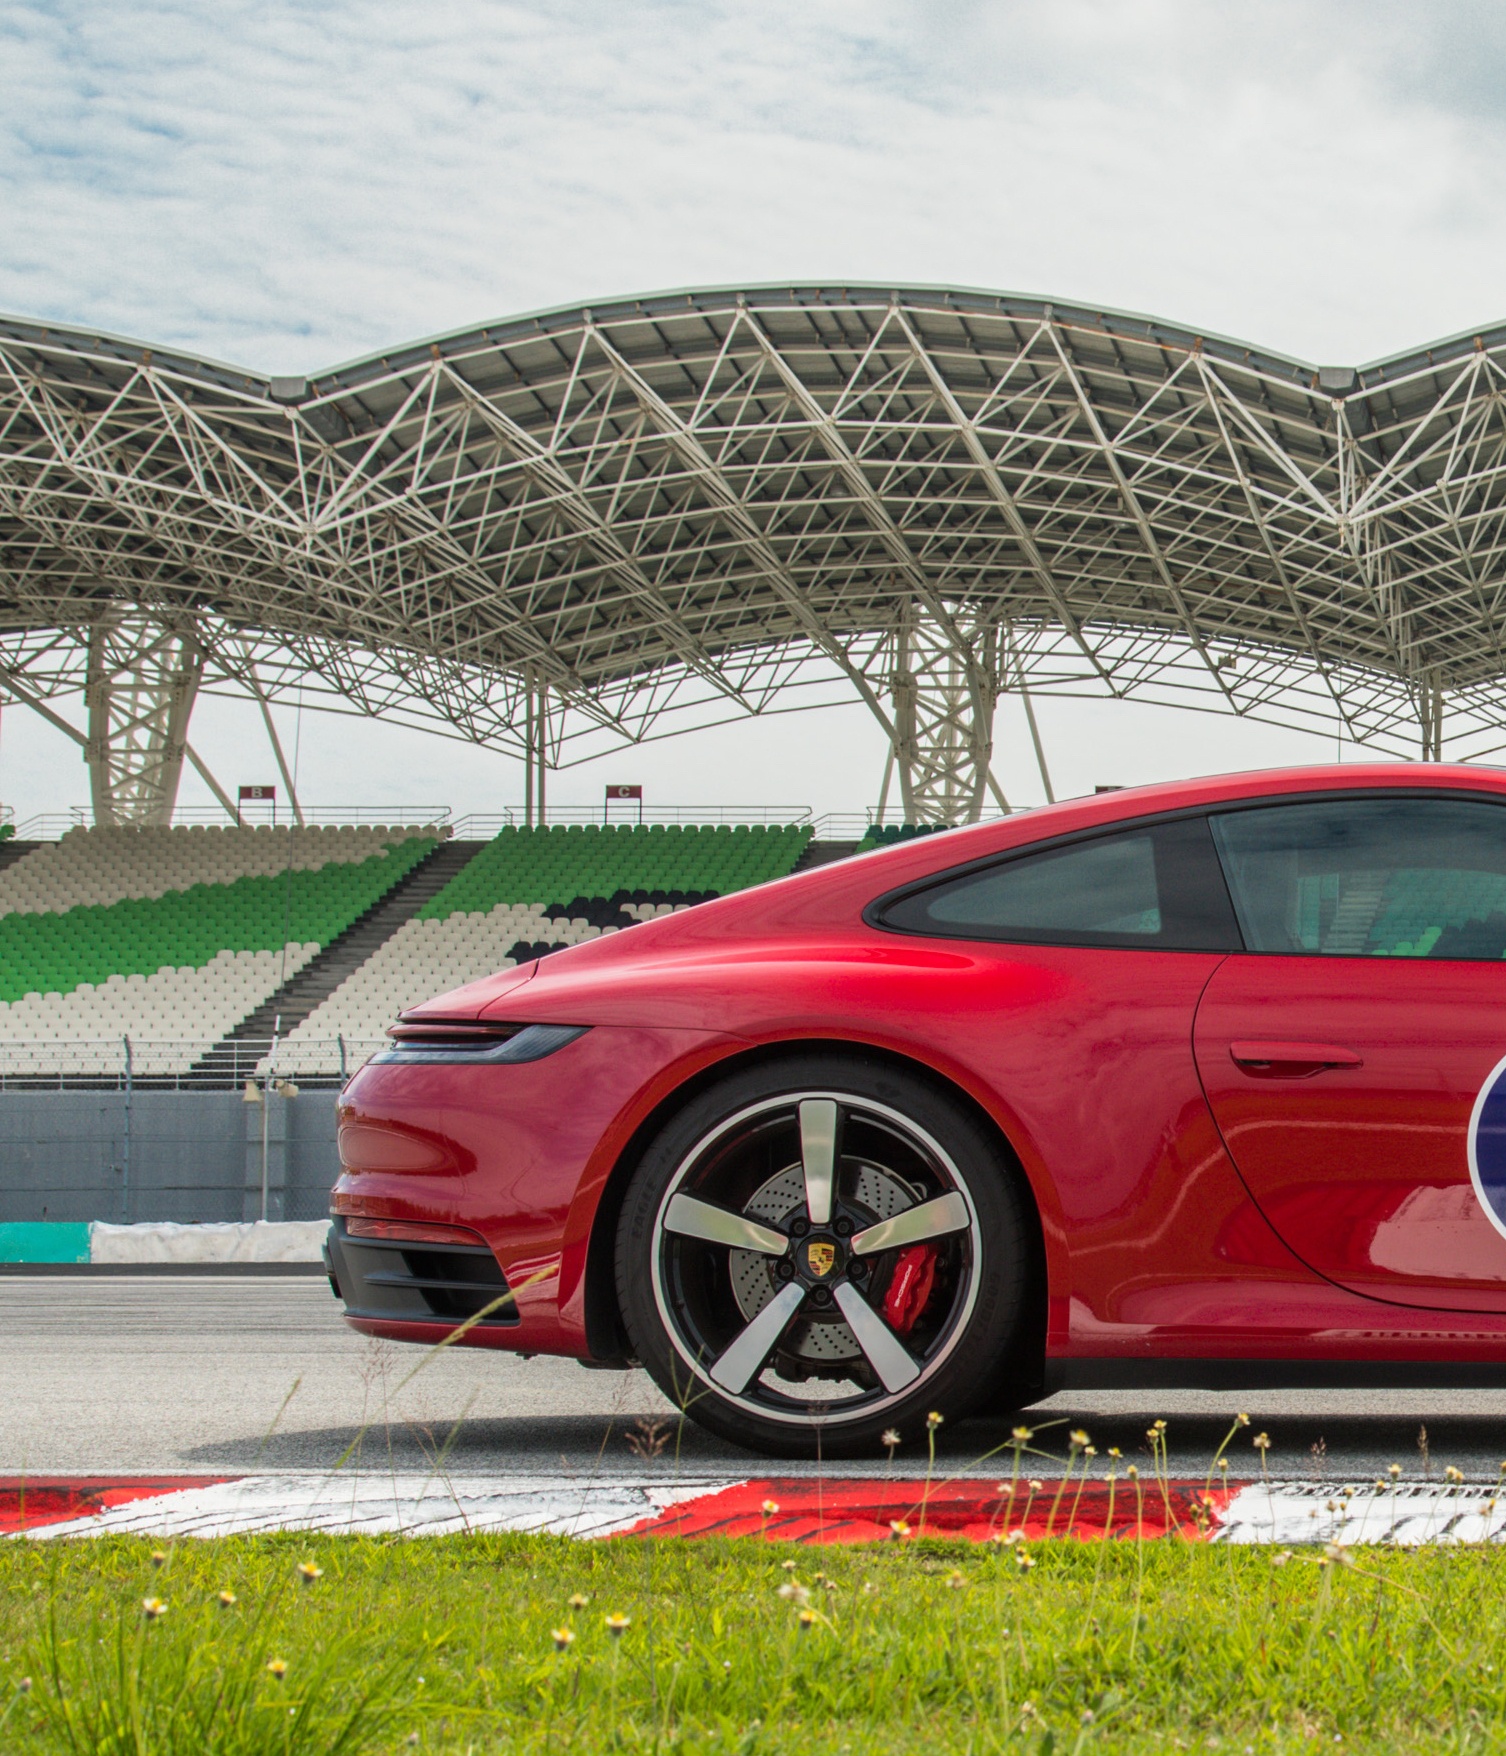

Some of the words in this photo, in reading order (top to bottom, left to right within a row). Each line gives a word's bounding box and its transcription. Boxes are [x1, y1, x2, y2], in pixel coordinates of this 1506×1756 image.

[251, 787, 263, 798] B
[618, 786, 630, 798] C
[894, 1264, 913, 1308] PORSCHE
